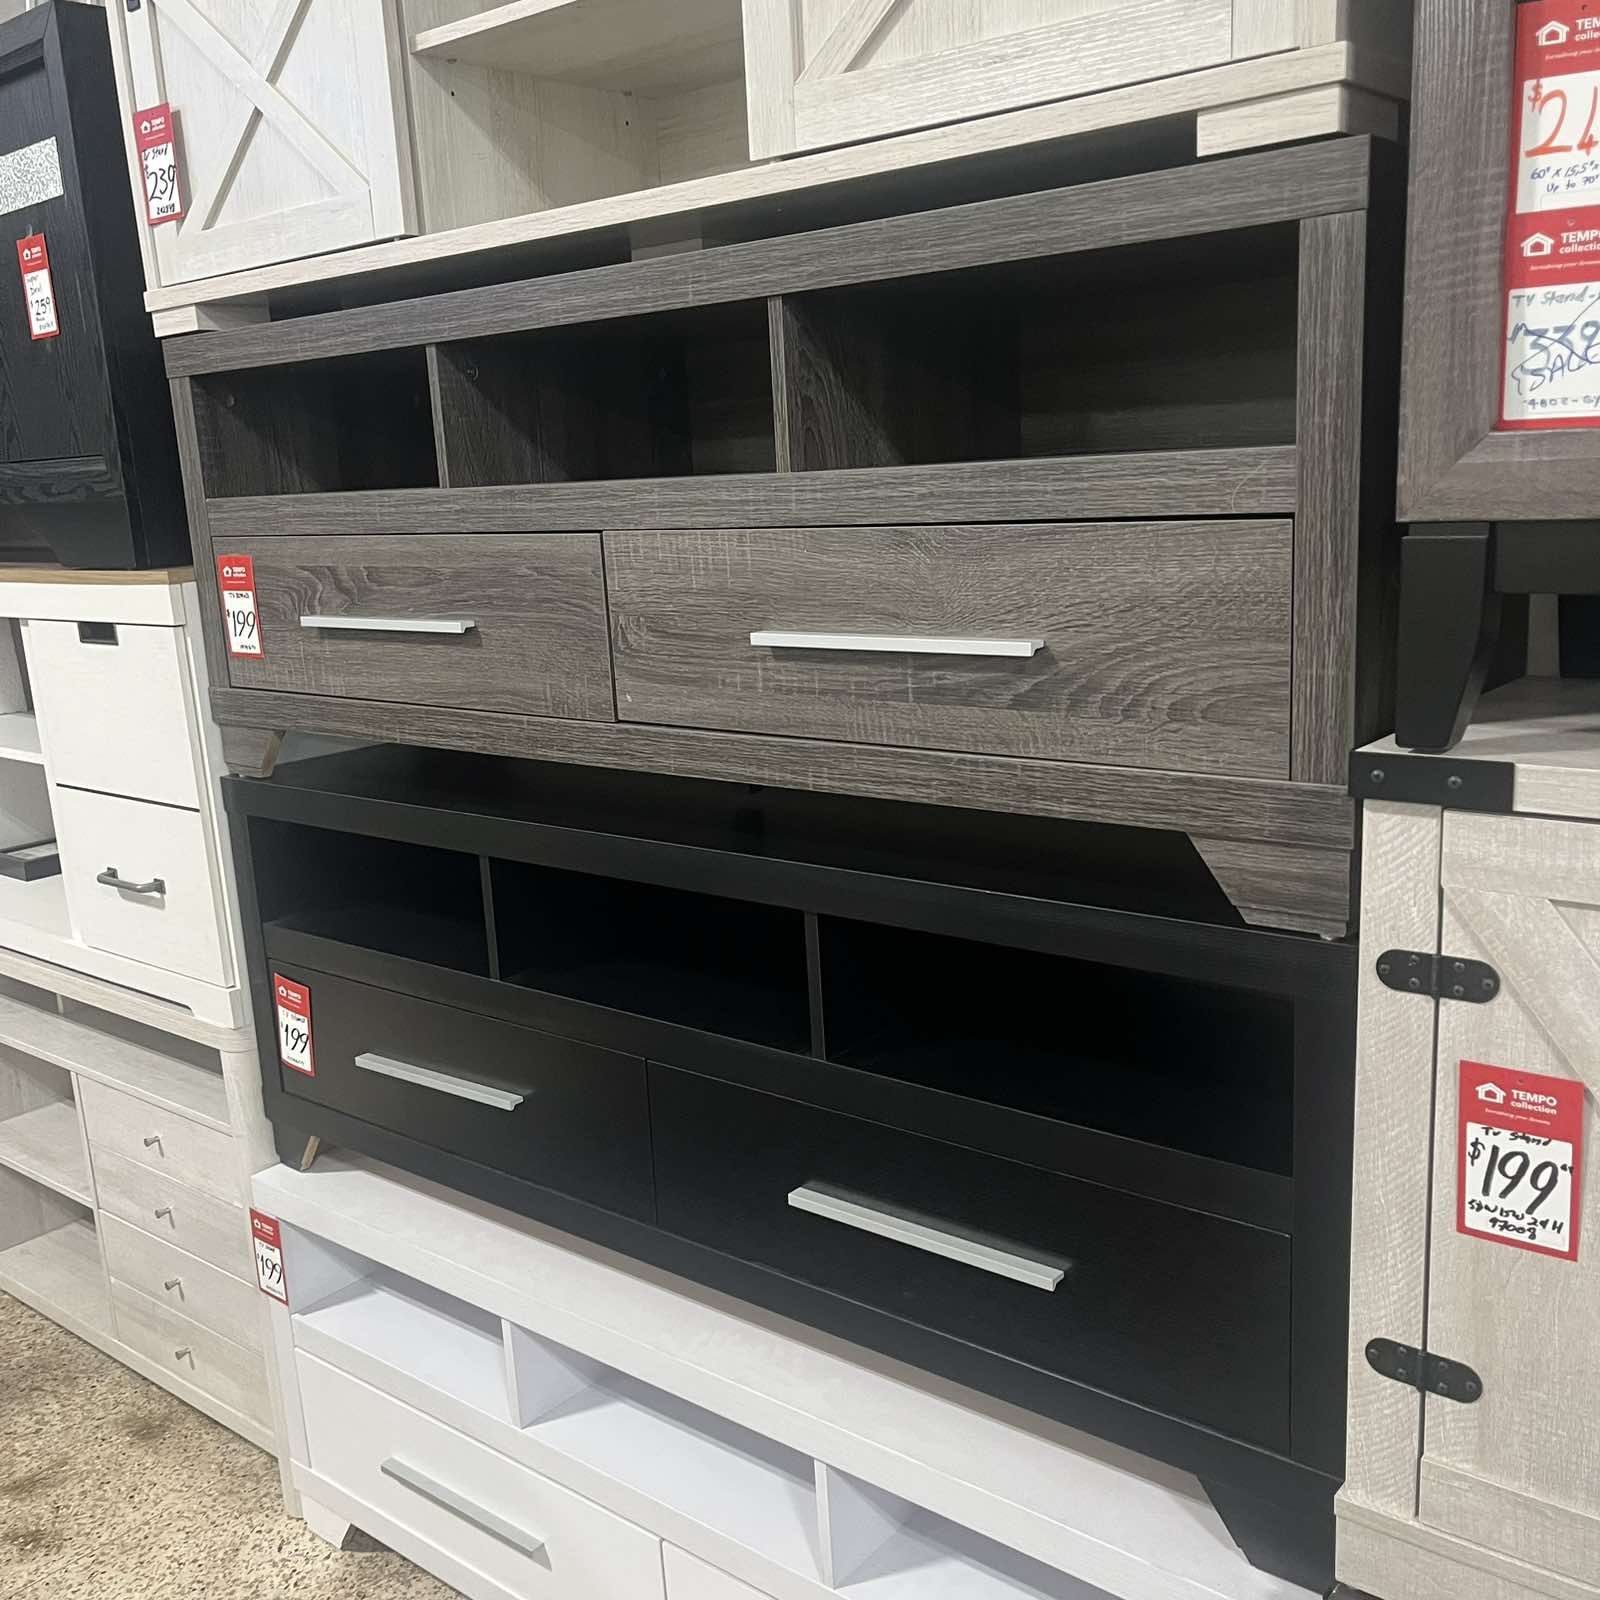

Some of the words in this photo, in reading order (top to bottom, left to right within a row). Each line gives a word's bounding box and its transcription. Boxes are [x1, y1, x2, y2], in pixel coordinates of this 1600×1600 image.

[1560, 229, 1600, 244] TEMP
[1511, 1089, 1557, 1106] TEMPO
[1510, 1100, 1557, 1115] collection
